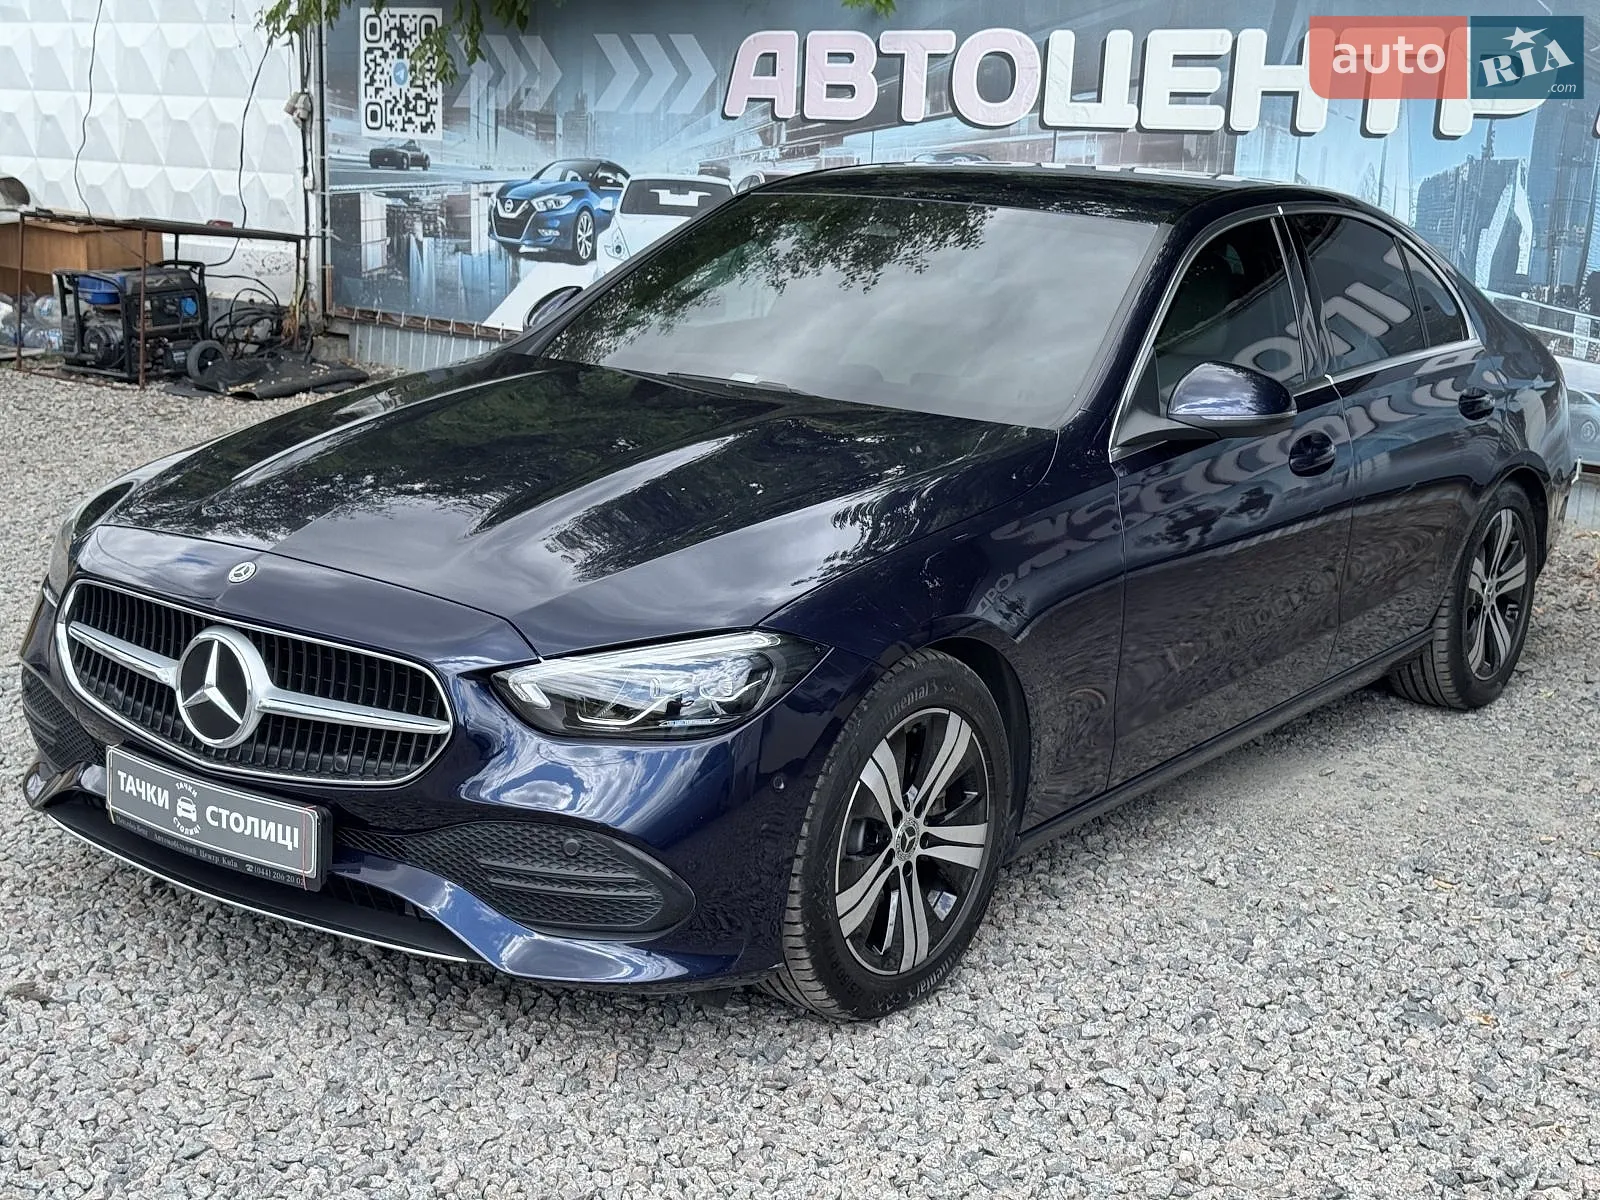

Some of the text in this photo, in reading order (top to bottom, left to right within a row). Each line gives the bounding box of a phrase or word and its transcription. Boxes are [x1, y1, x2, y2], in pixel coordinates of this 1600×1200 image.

[722, 26, 1558, 137] АВТОЦЕНТР
[175, 782, 198, 798] ТАЧКИ
[117, 770, 299, 851] ТАЧКИ СТОЛИЦІ
[172, 816, 201, 836] СТОЛИЦІ
[286, 874, 295, 883] 20
